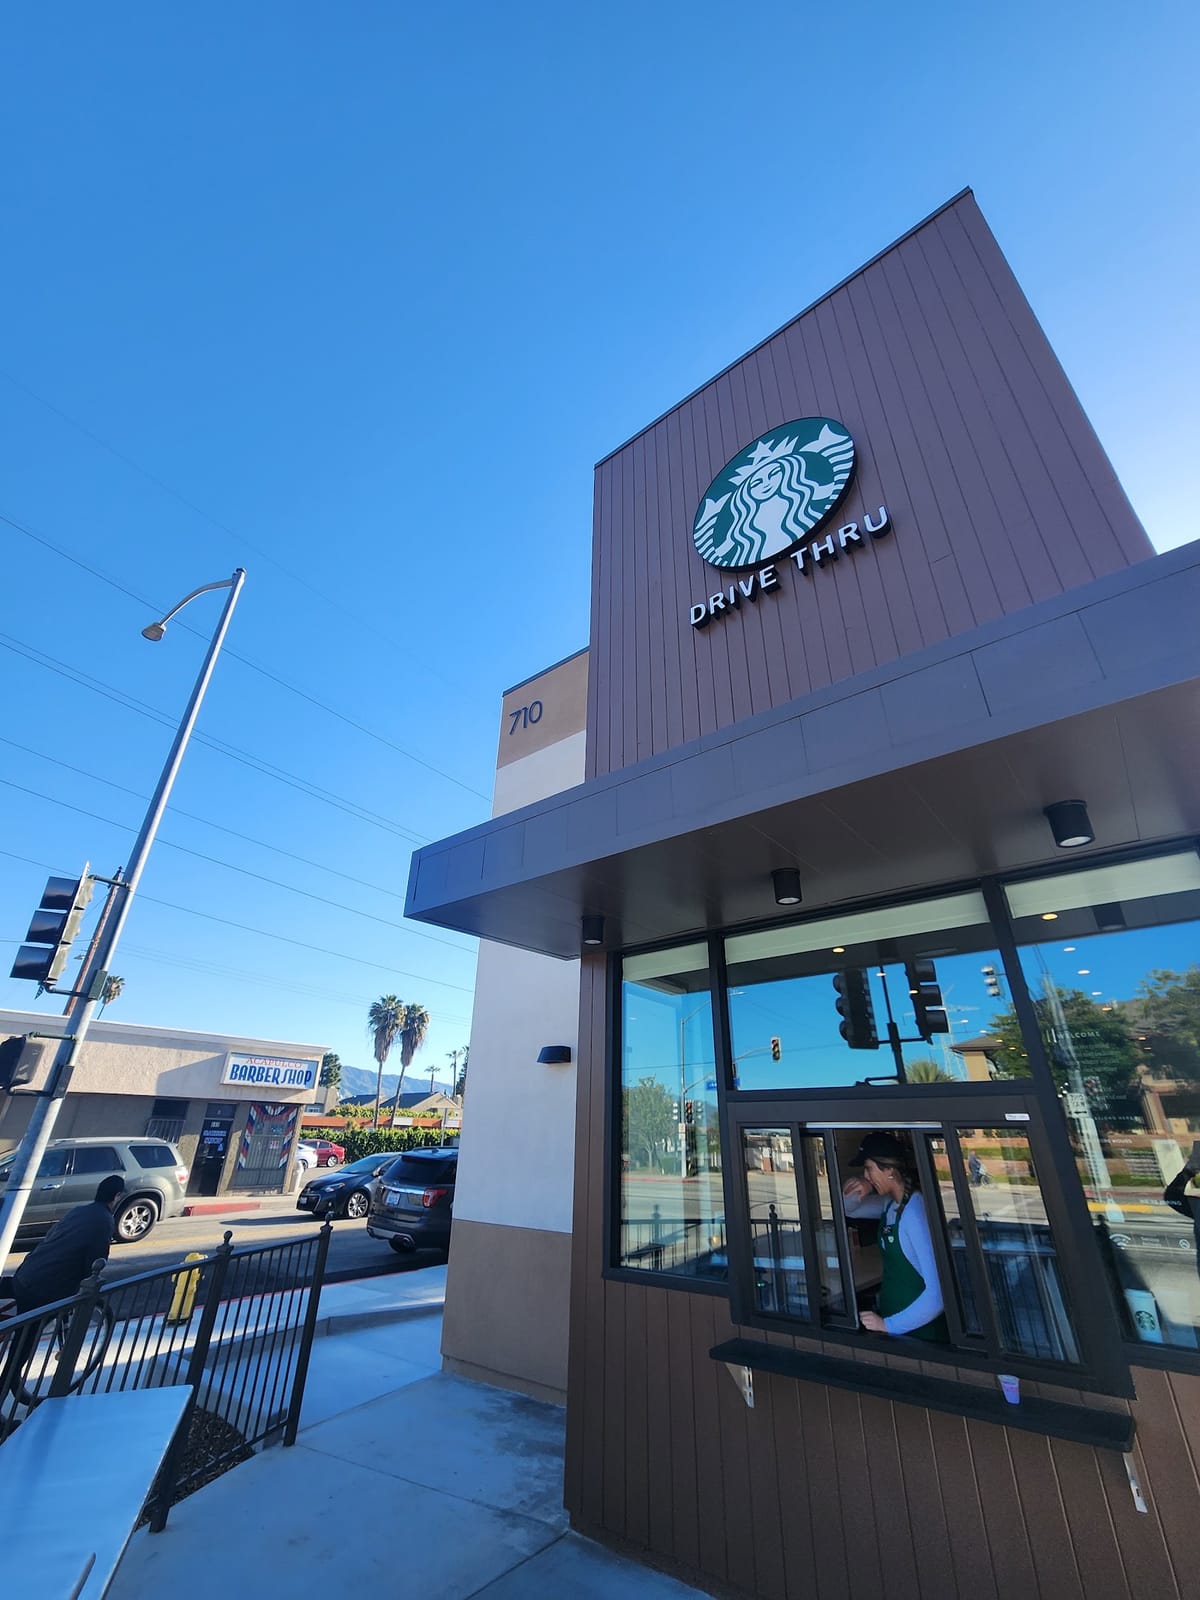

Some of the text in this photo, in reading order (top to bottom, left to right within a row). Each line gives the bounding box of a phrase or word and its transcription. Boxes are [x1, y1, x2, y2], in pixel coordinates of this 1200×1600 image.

[689, 505, 890, 627] DRIVE THRU
[509, 700, 543, 735] 710
[229, 1063, 312, 1086] BARBER SHOP
